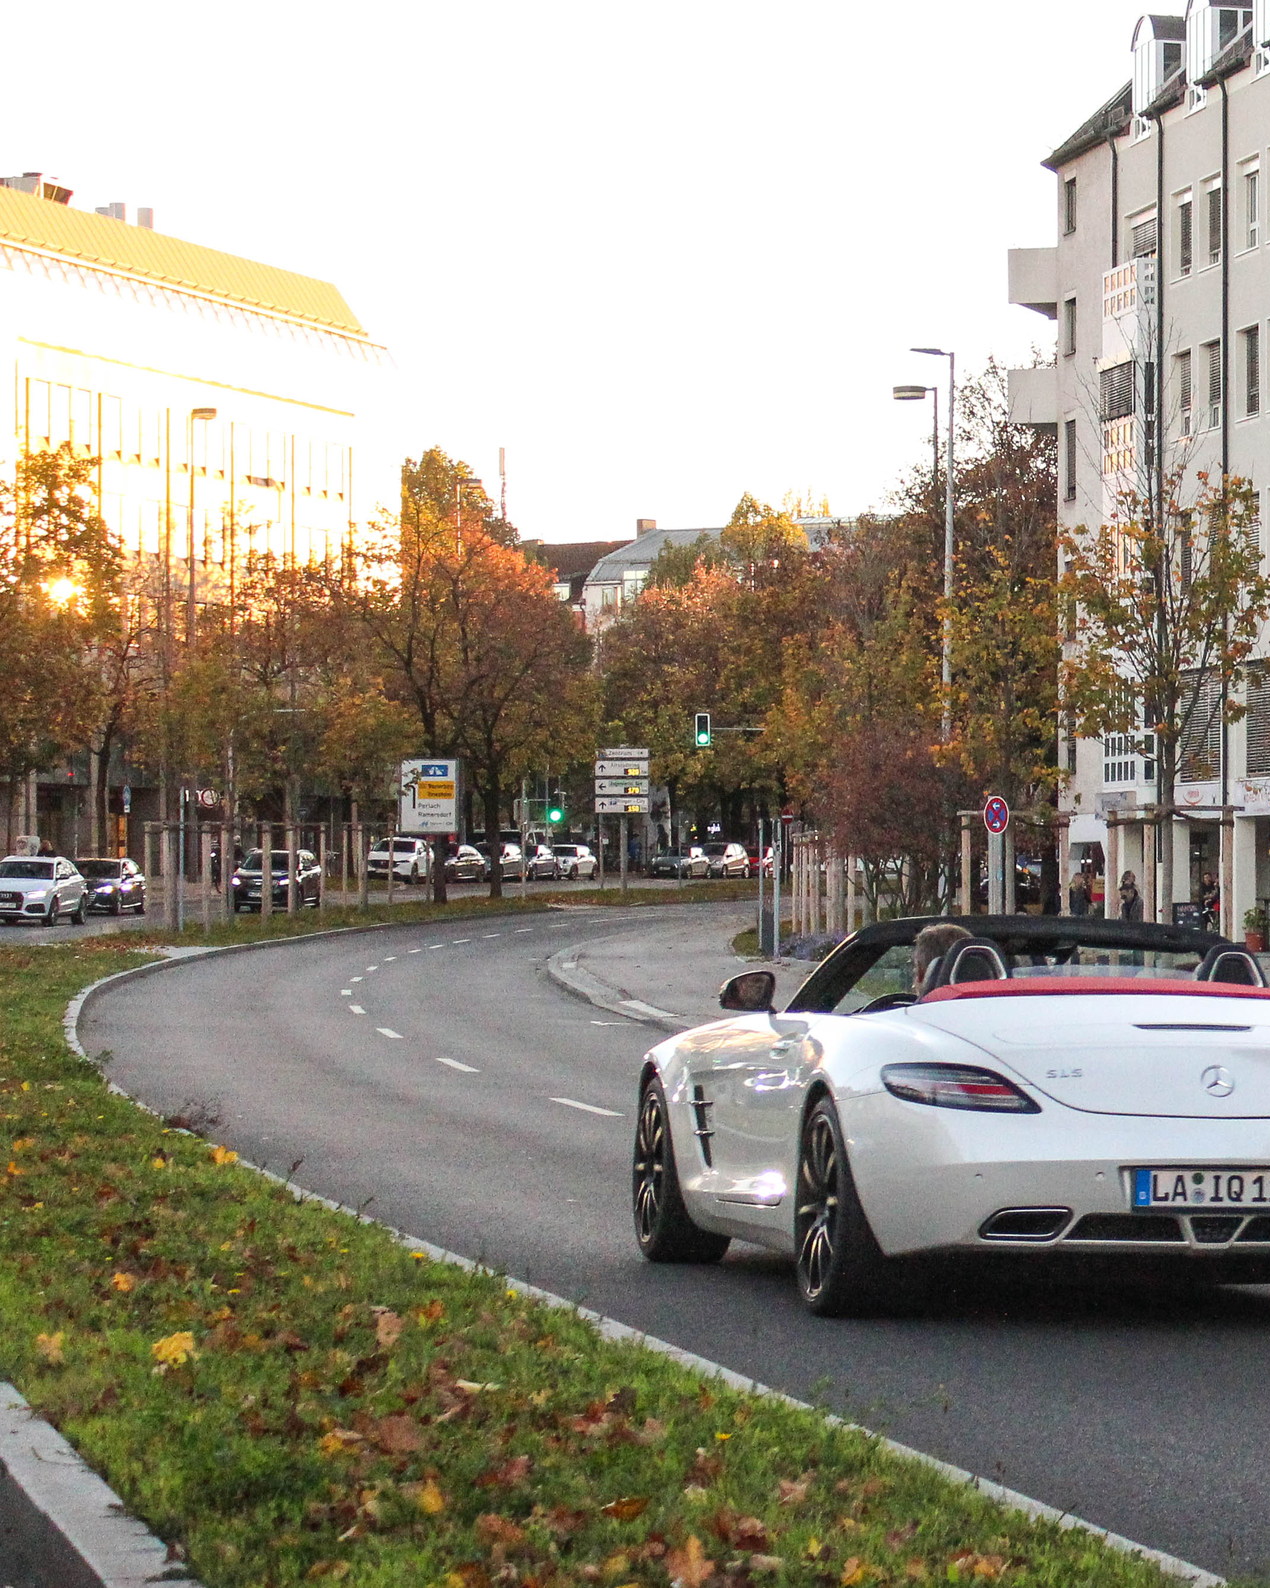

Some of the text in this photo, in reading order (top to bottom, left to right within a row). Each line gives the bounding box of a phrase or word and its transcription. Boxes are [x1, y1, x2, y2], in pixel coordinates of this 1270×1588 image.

[1046, 1069, 1083, 1078] SLS
[1152, 1174, 1187, 1202] LA
[1210, 1175, 1244, 1202] IQ
